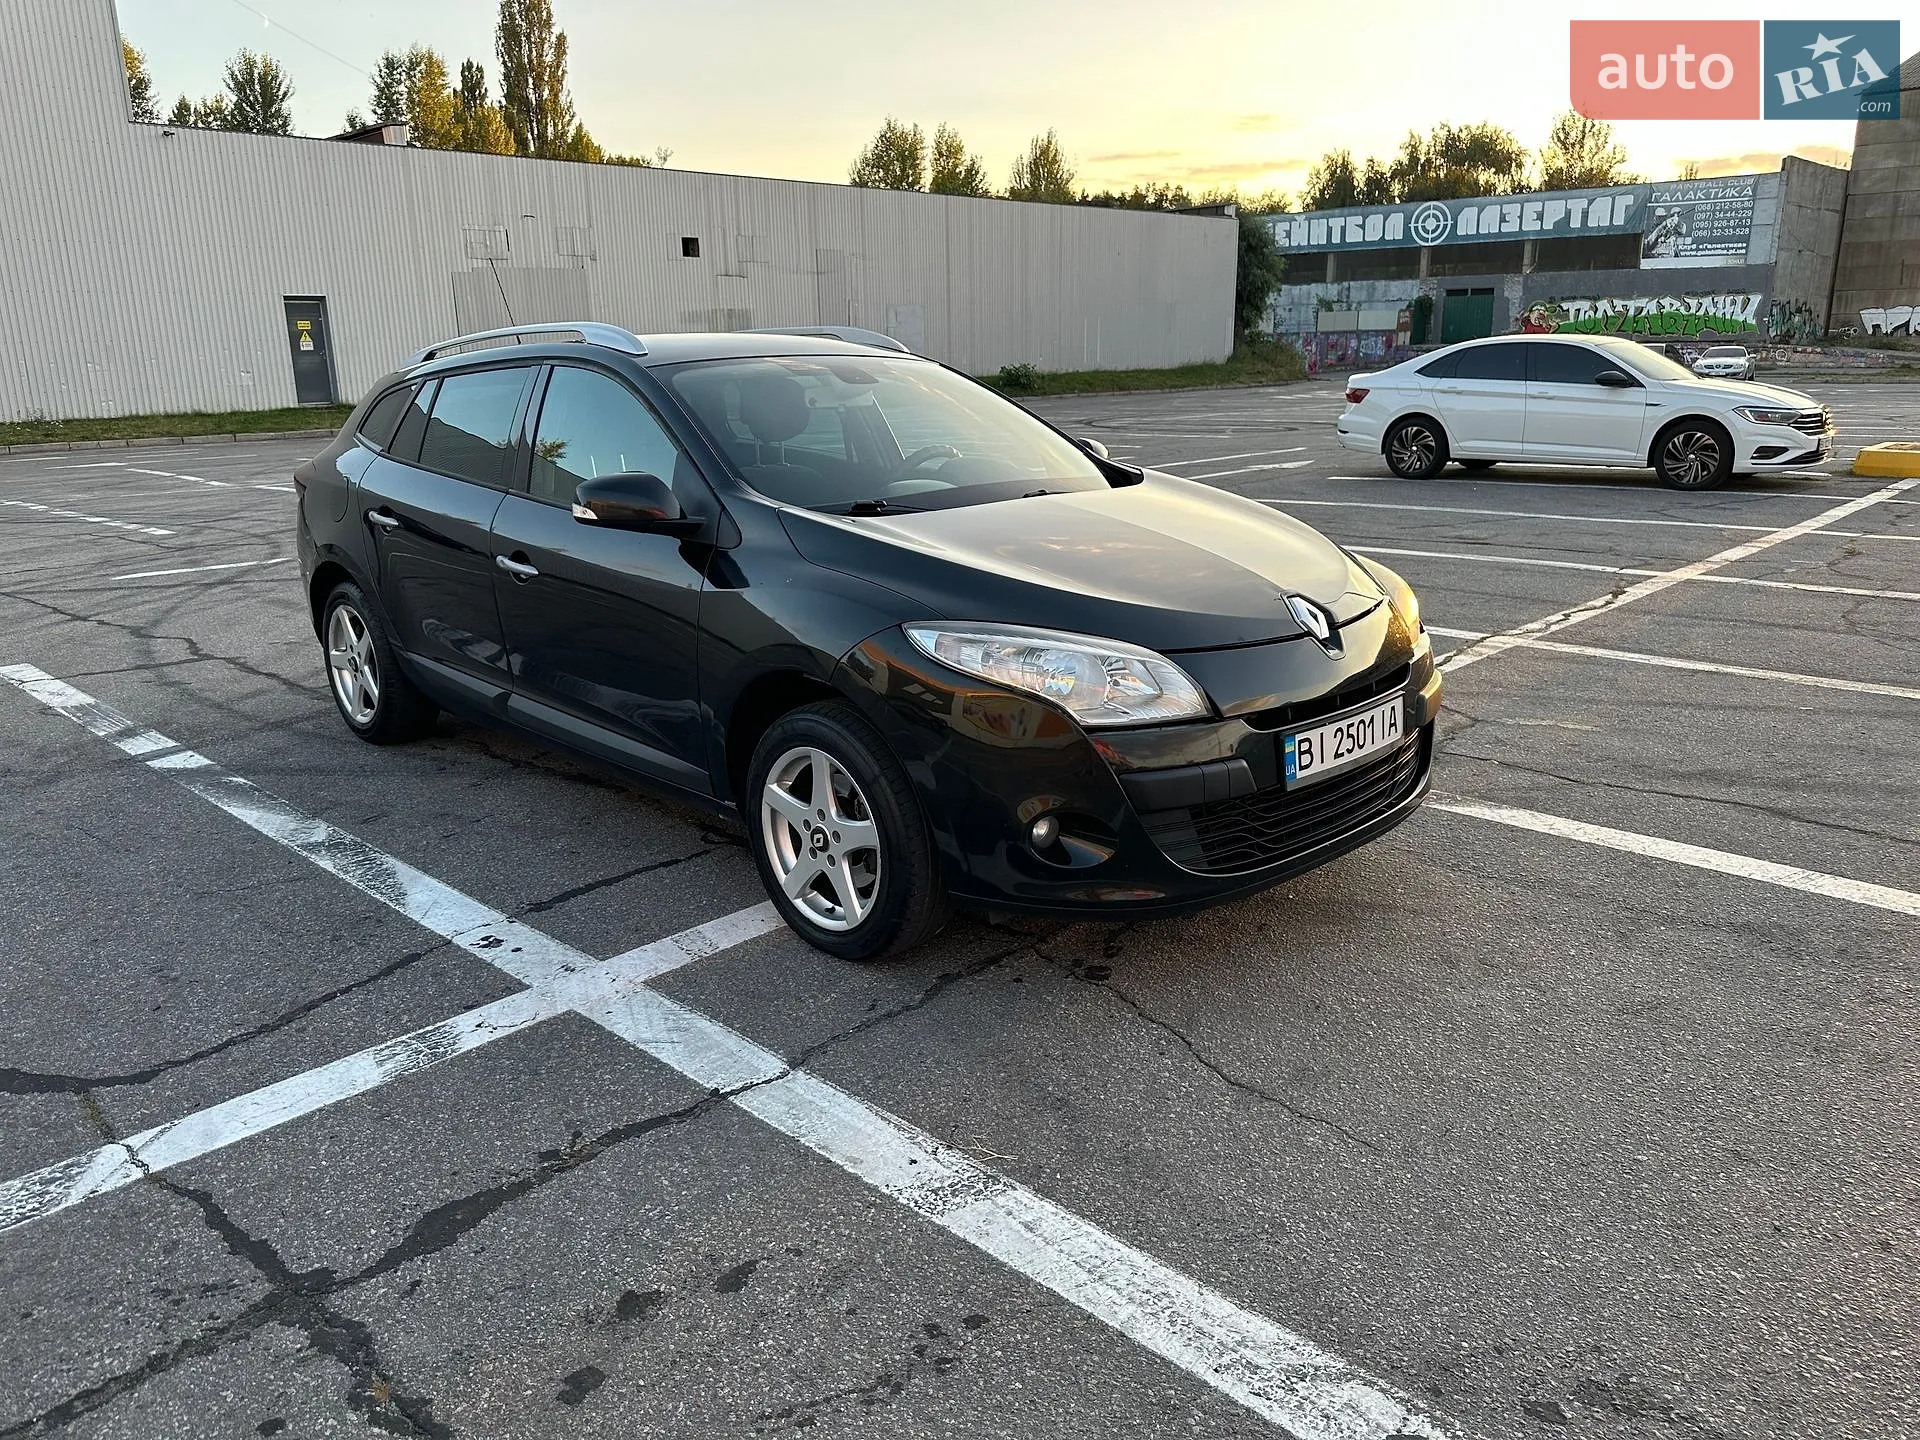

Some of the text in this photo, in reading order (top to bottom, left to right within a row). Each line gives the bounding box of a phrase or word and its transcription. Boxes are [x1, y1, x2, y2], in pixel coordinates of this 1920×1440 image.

[1670, 177, 1755, 191] PAINTBALL CLUB
[1651, 186, 1753, 202] ГАЛАКТИКА
[1456, 194, 1634, 236] ЛАЗЕРТАГ
[1298, 705, 1398, 771] BI 2501 IA
[1285, 764, 1296, 776] UA
